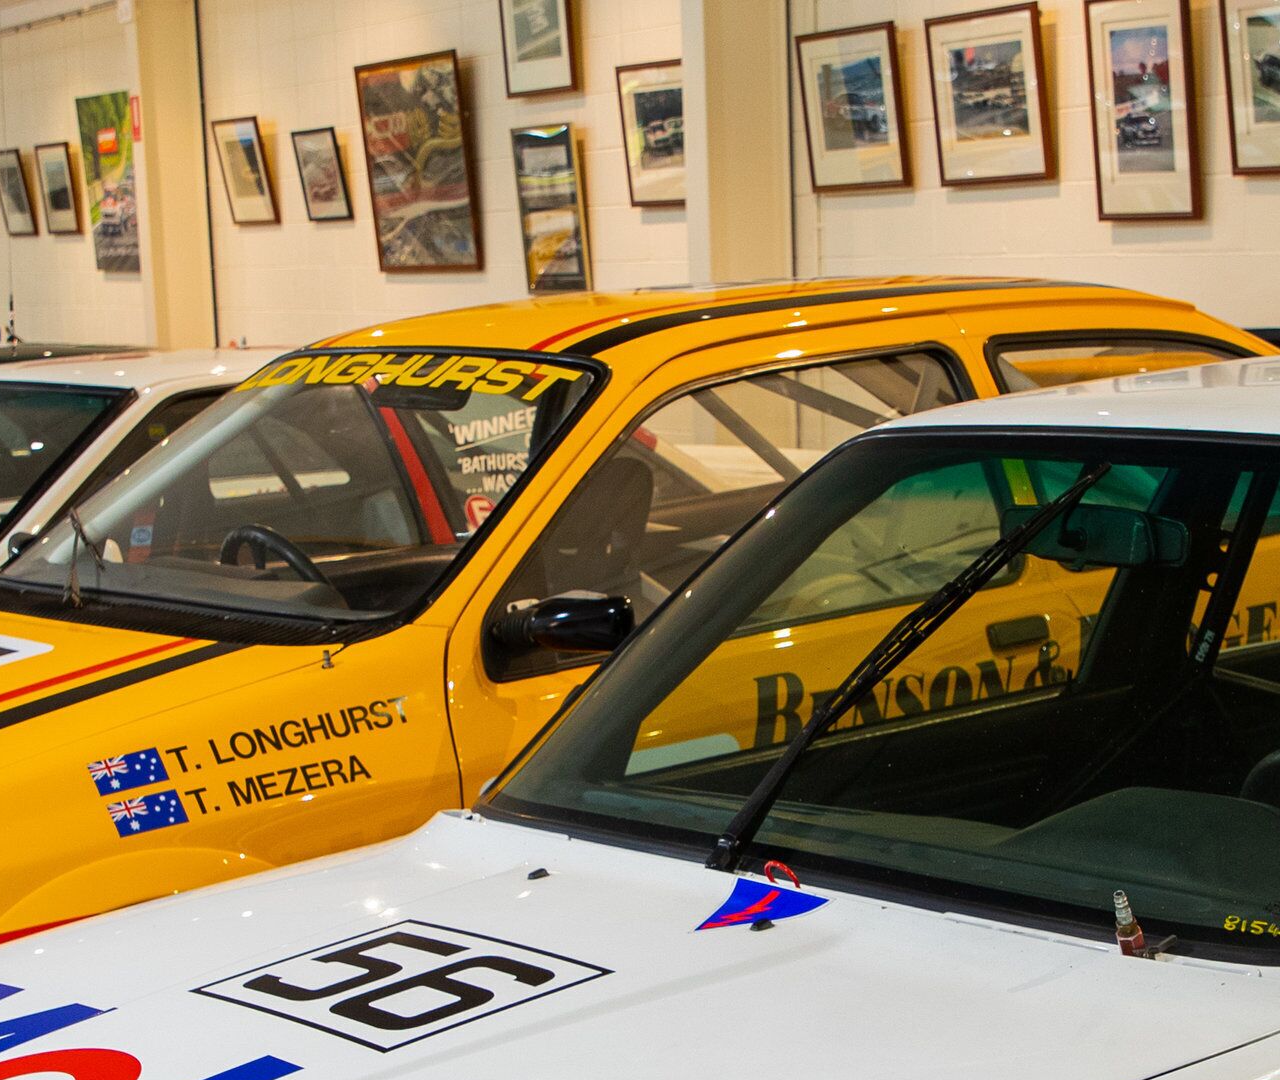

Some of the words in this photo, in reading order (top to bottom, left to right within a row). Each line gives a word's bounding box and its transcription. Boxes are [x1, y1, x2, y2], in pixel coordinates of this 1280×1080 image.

[234, 353, 583, 402] LONGHURST
[165, 745, 202, 774] T.
[208, 695, 409, 766] LONGHURST
[753, 656, 1014, 749] BNSON
[184, 787, 221, 815] T.
[227, 754, 372, 808] MEZERA
[242, 931, 556, 1032] 56
